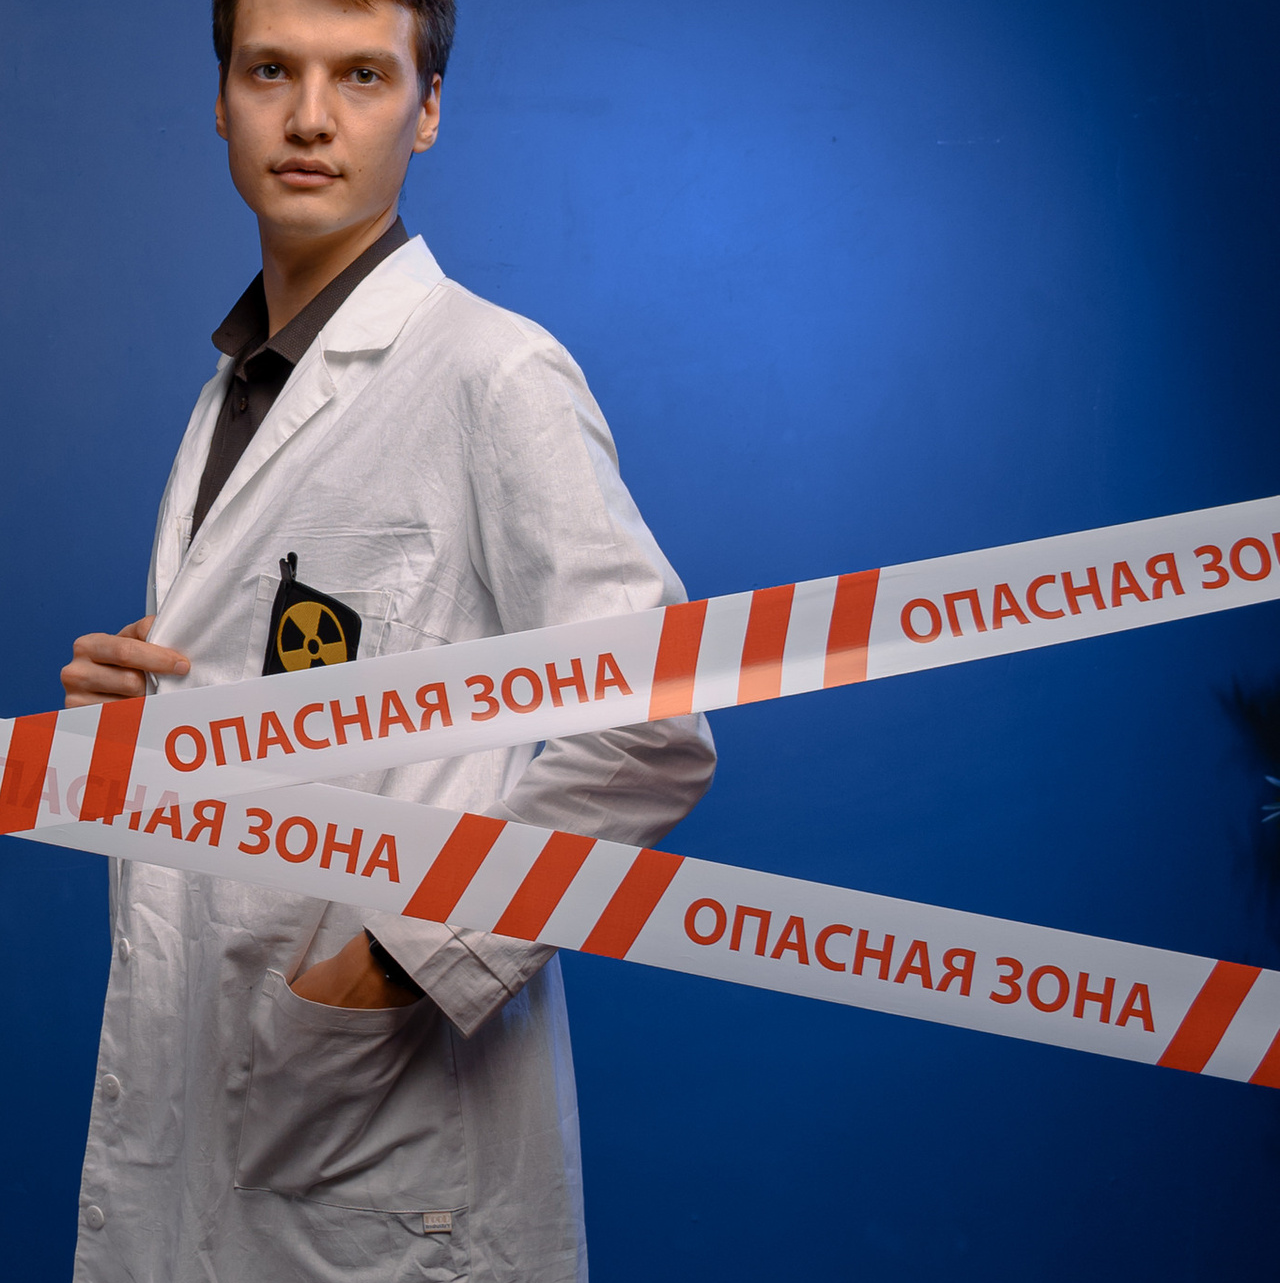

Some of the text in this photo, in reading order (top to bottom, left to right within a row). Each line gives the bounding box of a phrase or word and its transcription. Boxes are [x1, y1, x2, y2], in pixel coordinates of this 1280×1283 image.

[900, 532, 1280, 644] ОПАСНАЯ ЗО
[164, 652, 634, 773] ОПАСНАЯ ЗОНА
[237, 807, 400, 883] ЗОНА
[683, 898, 1156, 1033] ОПАСНАЯ ЗОНА
